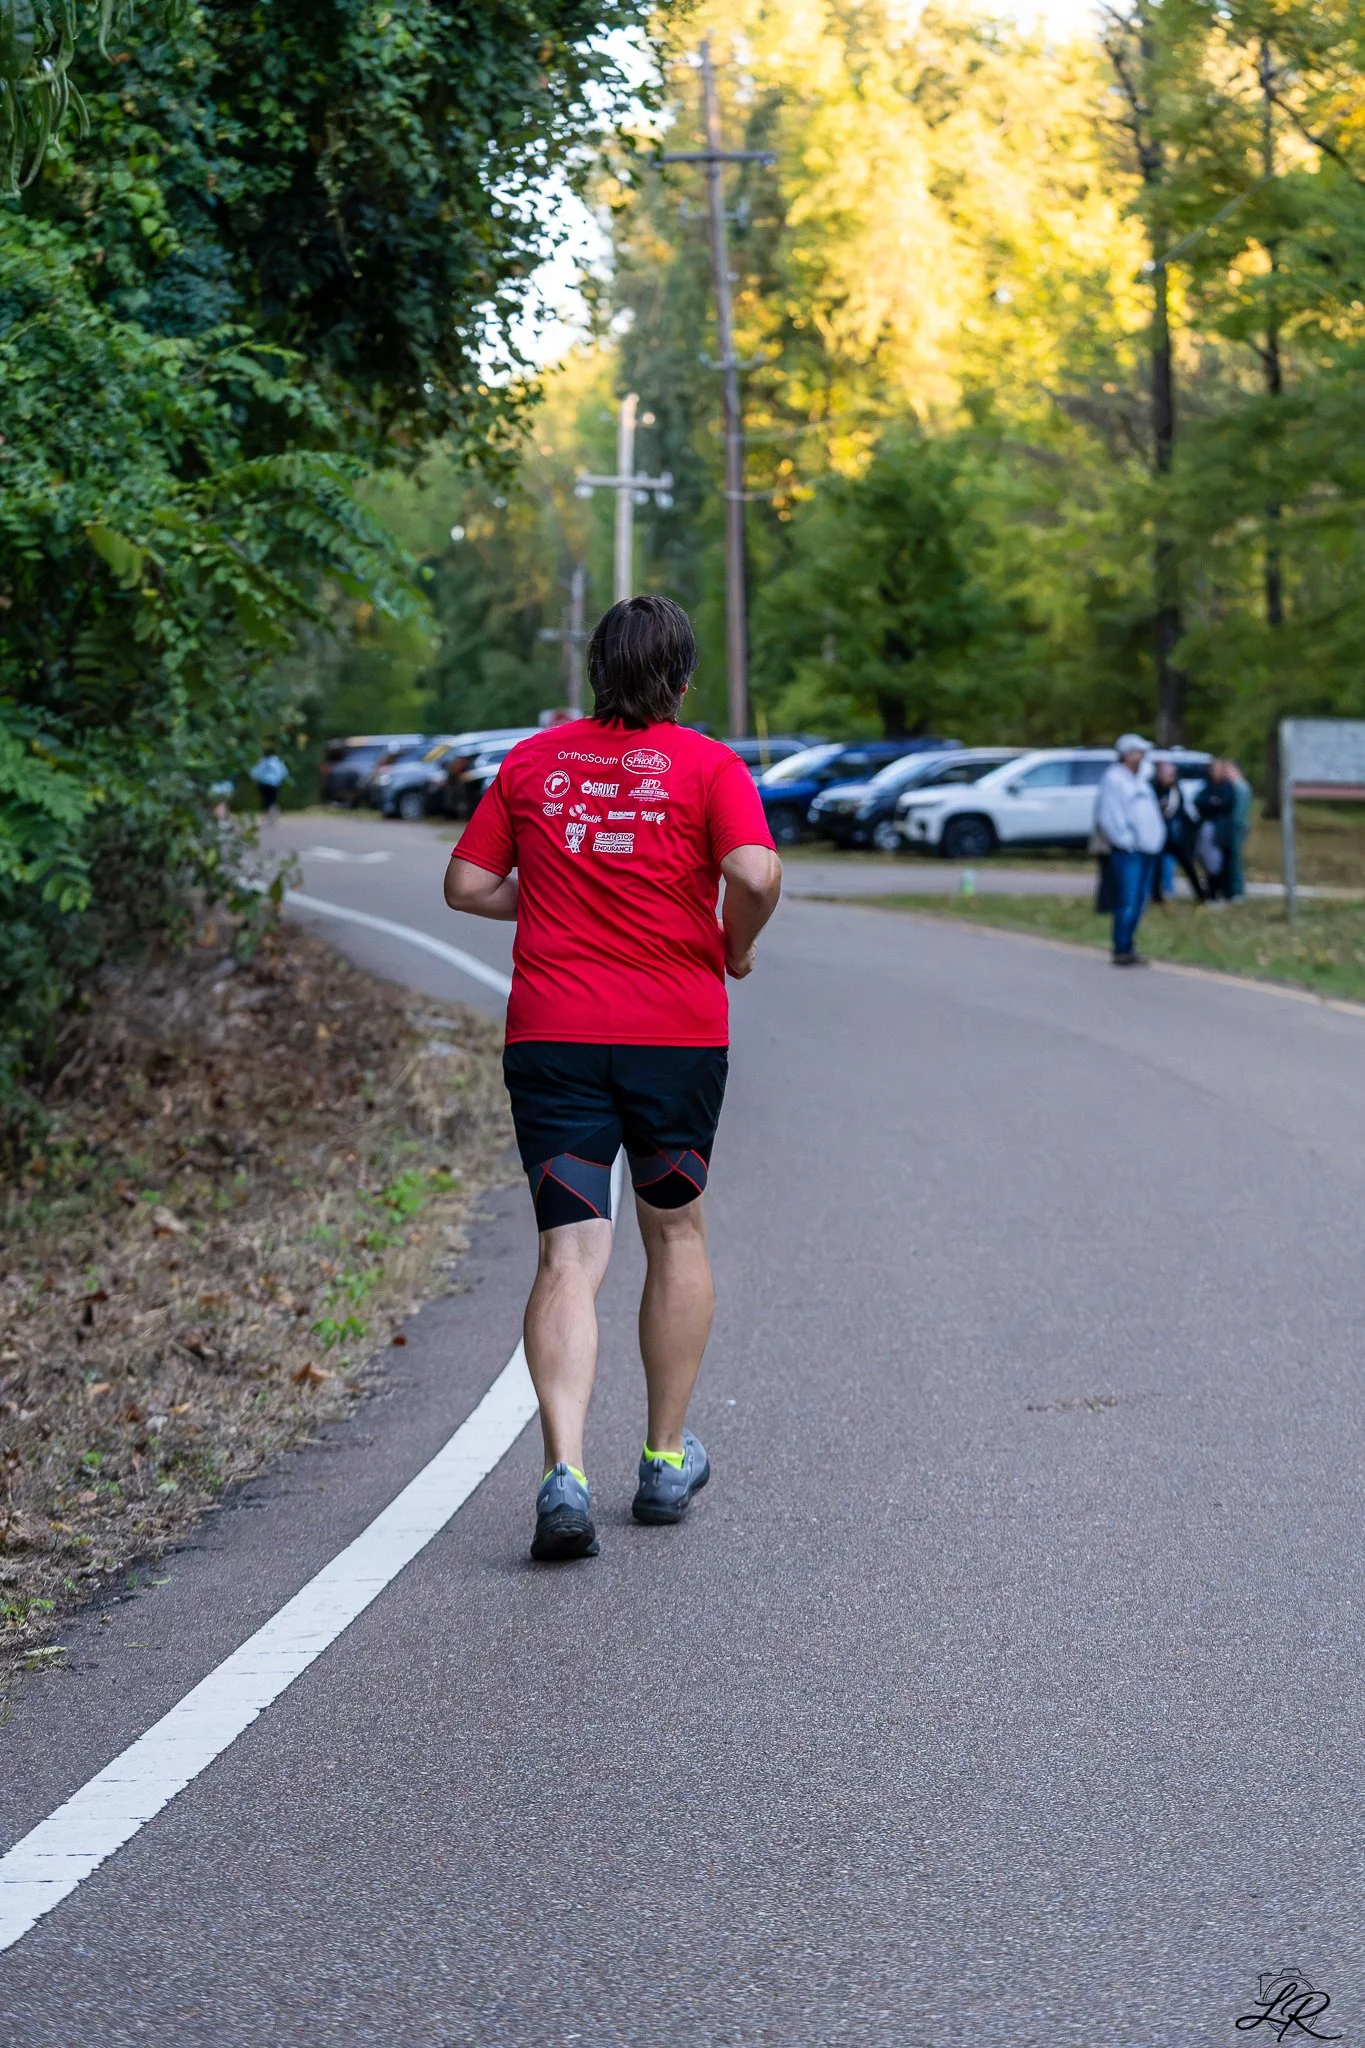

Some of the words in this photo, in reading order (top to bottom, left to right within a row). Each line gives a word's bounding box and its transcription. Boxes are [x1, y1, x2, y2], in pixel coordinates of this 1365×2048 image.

[557, 751, 618, 765] OrthoSouth
[625, 756, 667, 769] SPROUTS
[592, 782, 620, 794] GRIVET
[641, 778, 661, 789] BPD
[580, 813, 602, 823] BioLife
[566, 822, 587, 834] RRCA
[616, 833, 634, 841] STOP
[594, 845, 632, 853] ENDURANCE
